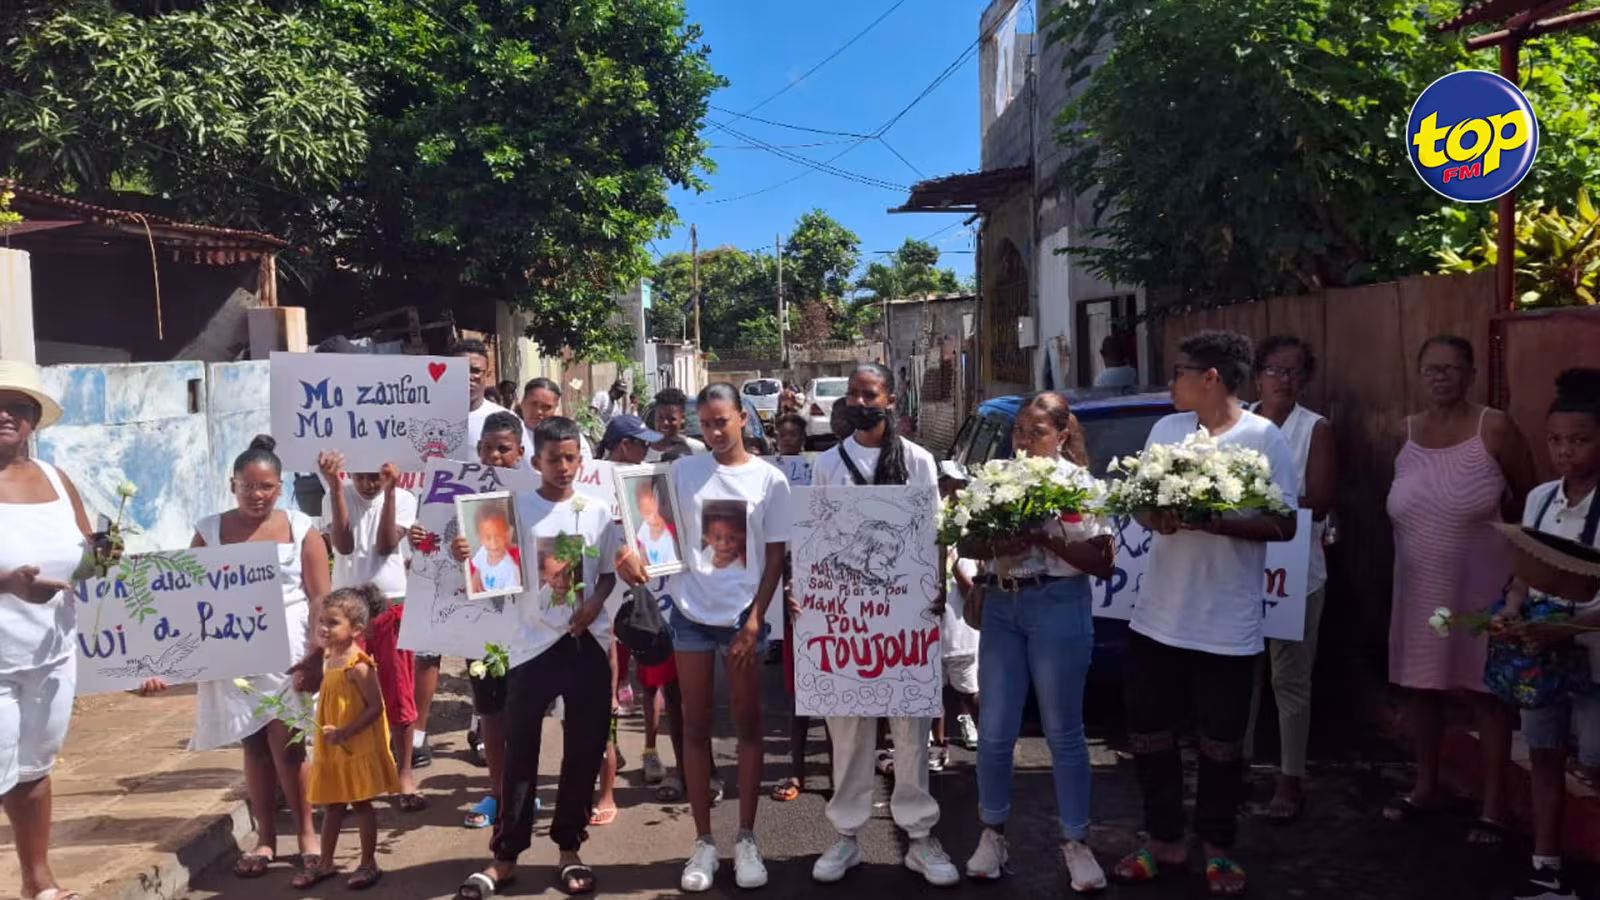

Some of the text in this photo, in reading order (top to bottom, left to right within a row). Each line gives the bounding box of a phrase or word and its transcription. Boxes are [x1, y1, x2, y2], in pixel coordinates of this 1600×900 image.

[298, 377, 343, 409] Mo
[294, 411, 407, 439] Mo la vie
